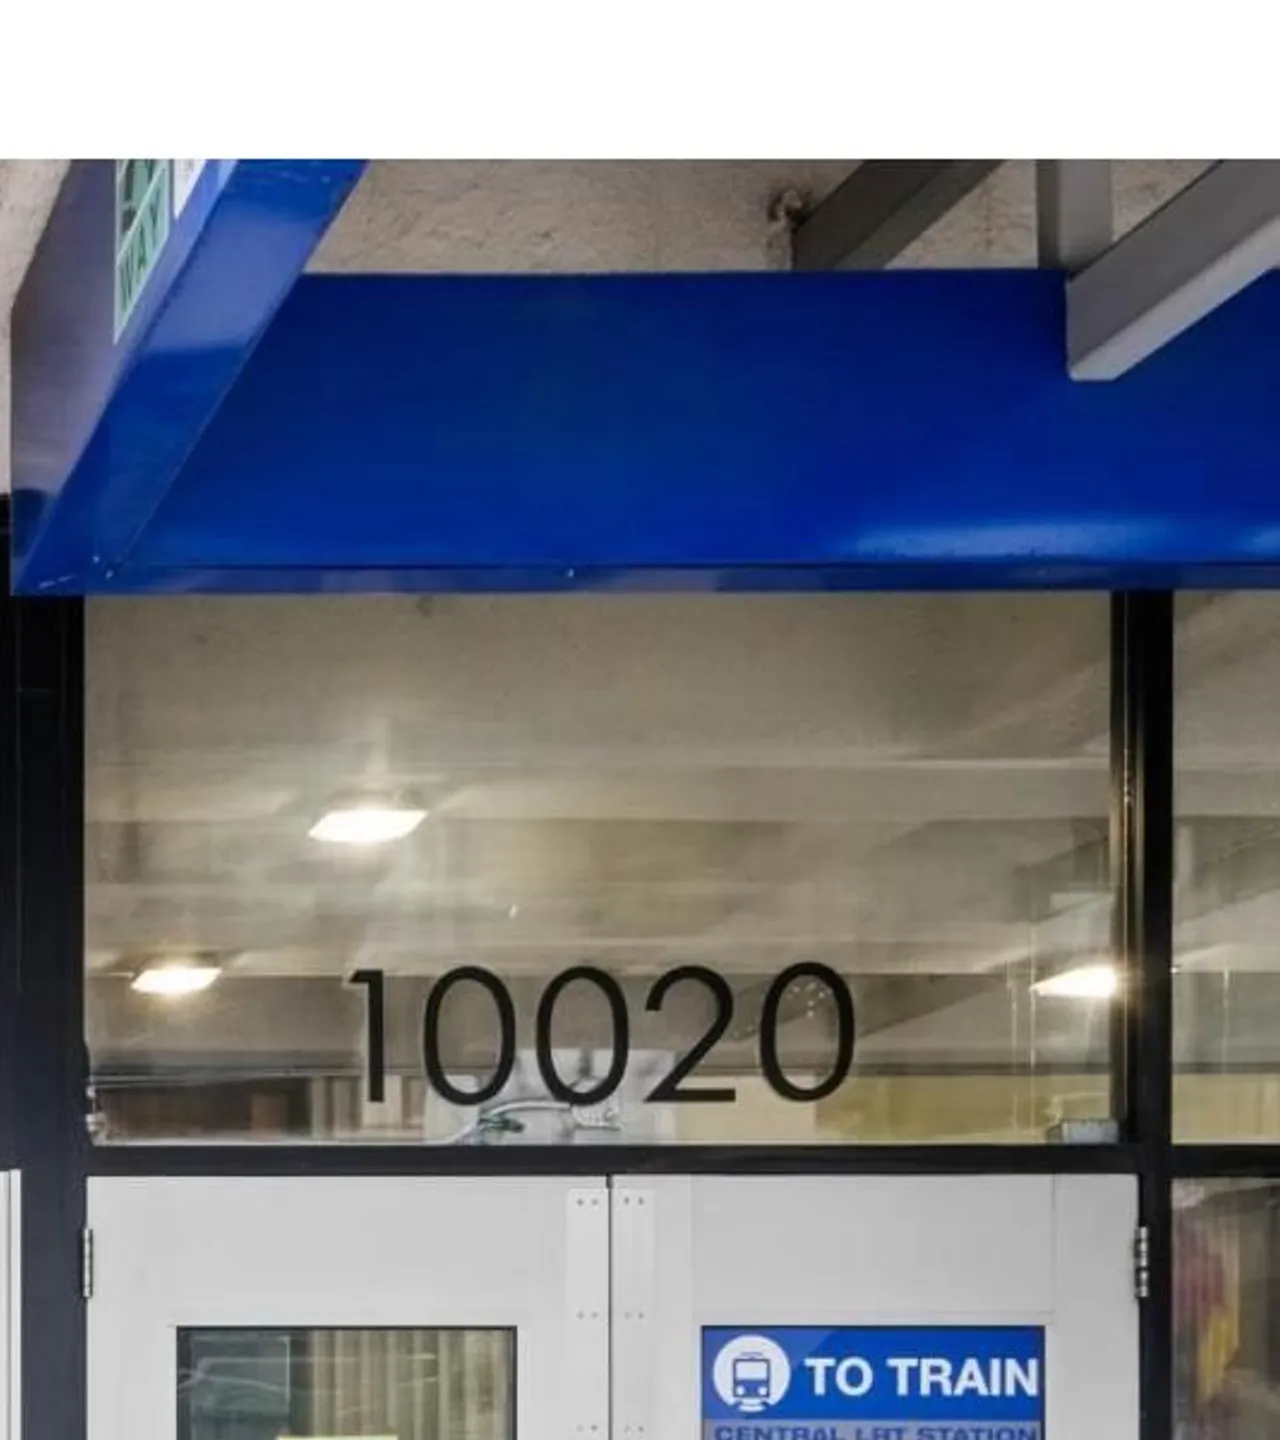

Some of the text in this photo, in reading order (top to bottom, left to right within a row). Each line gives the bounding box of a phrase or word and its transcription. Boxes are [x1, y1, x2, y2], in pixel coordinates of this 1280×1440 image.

[348, 961, 856, 1105] 10020
[804, 1356, 1039, 1397] TO TRAIN
